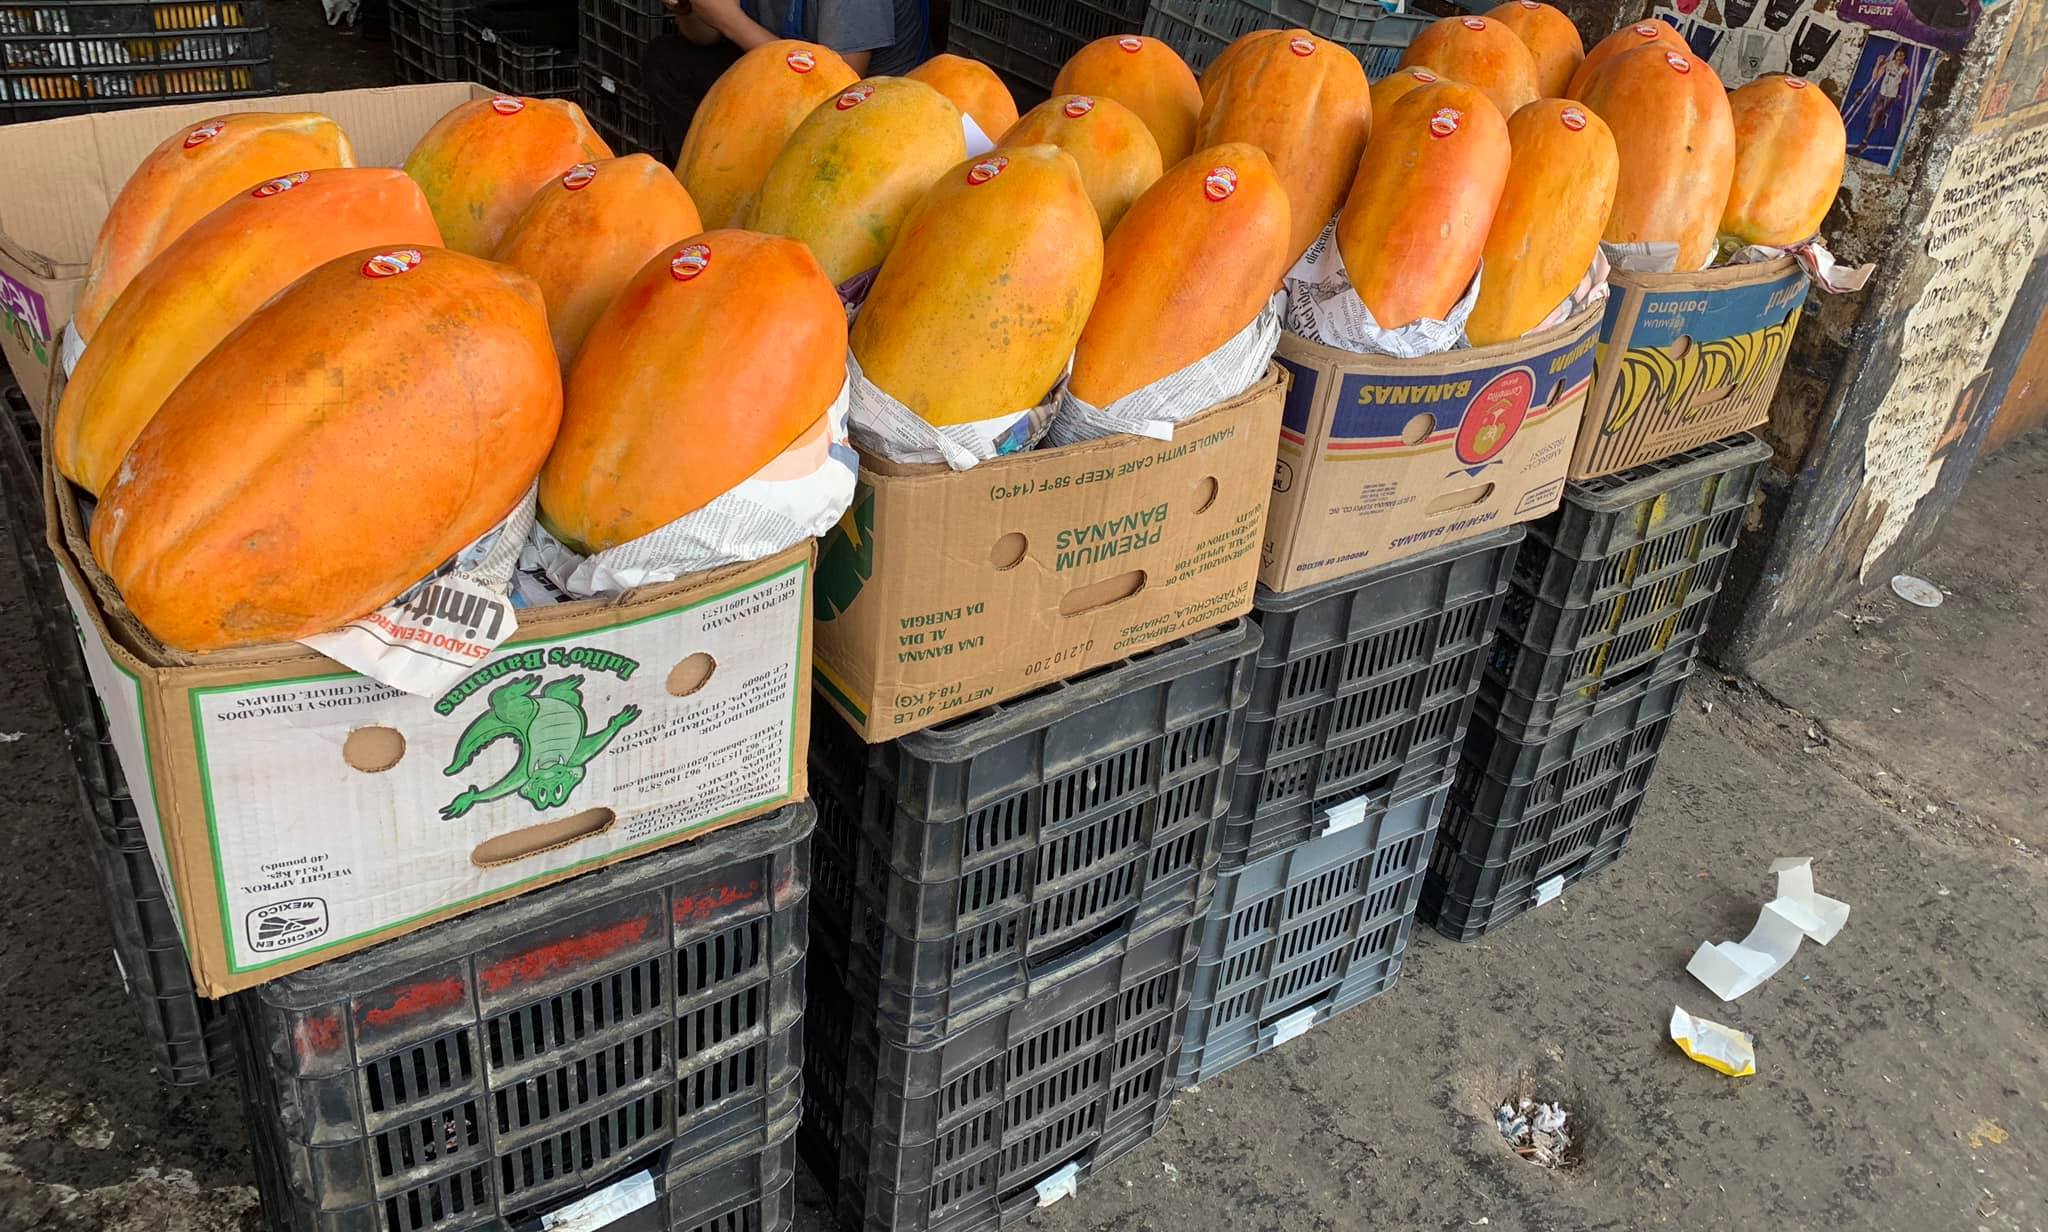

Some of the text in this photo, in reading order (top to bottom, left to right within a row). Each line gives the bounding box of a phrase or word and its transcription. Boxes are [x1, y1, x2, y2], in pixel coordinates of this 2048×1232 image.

[1647, 300, 1708, 314] banana
[1356, 378, 1472, 405] BANANAS
[1188, 425, 1234, 456] HANDLE
[1117, 454, 1153, 476] CARE
[1156, 443, 1187, 464] WITH
[1075, 466, 1114, 484] KEEP
[1055, 502, 1168, 551] BANANAS
[1388, 509, 1498, 550] PREMIUM BANANAS
[1055, 524, 1162, 572] PREMIUM
[1295, 549, 1368, 572] PRODUCT OF MEXICO
[403, 585, 504, 640] Limit
[702, 588, 794, 632] GRUPO BANANAYO
[899, 601, 984, 631] DA ENERGIA
[1186, 594, 1246, 626] PRODUCIDO
[415, 628, 433, 644] DE
[432, 634, 491, 659] ESTADO
[898, 626, 946, 647] AL DIA
[1113, 622, 1176, 651] EMPACADO
[897, 634, 984, 664] UNA BANANA
[299, 682, 371, 699] SUCHIATE,
[434, 646, 640, 716] Lulito's Bananas
[235, 691, 296, 708] CHIAPAS
[317, 686, 407, 709] PRODUCIDOS
[748, 681, 785, 705] BODEGA
[894, 693, 924, 710] KG)
[938, 695, 961, 711] WT.
[963, 685, 993, 703] NET
[216, 702, 302, 722] EMPACADOS
[686, 698, 726, 721] CIUDAD
[723, 691, 784, 726] DISTRIBUIDO
[893, 710, 913, 724] LB
[678, 708, 725, 734] CENTRAL
[607, 734, 658, 756] ABASTOS
[638, 780, 661, 793] 5876
[259, 855, 306, 873] pounds)
[265, 864, 324, 882] 18.14 Kgs.
[239, 866, 351, 896] WEIGHT APPROX.
[256, 897, 314, 919] MEXICO
[254, 925, 322, 950] HECHO EN
